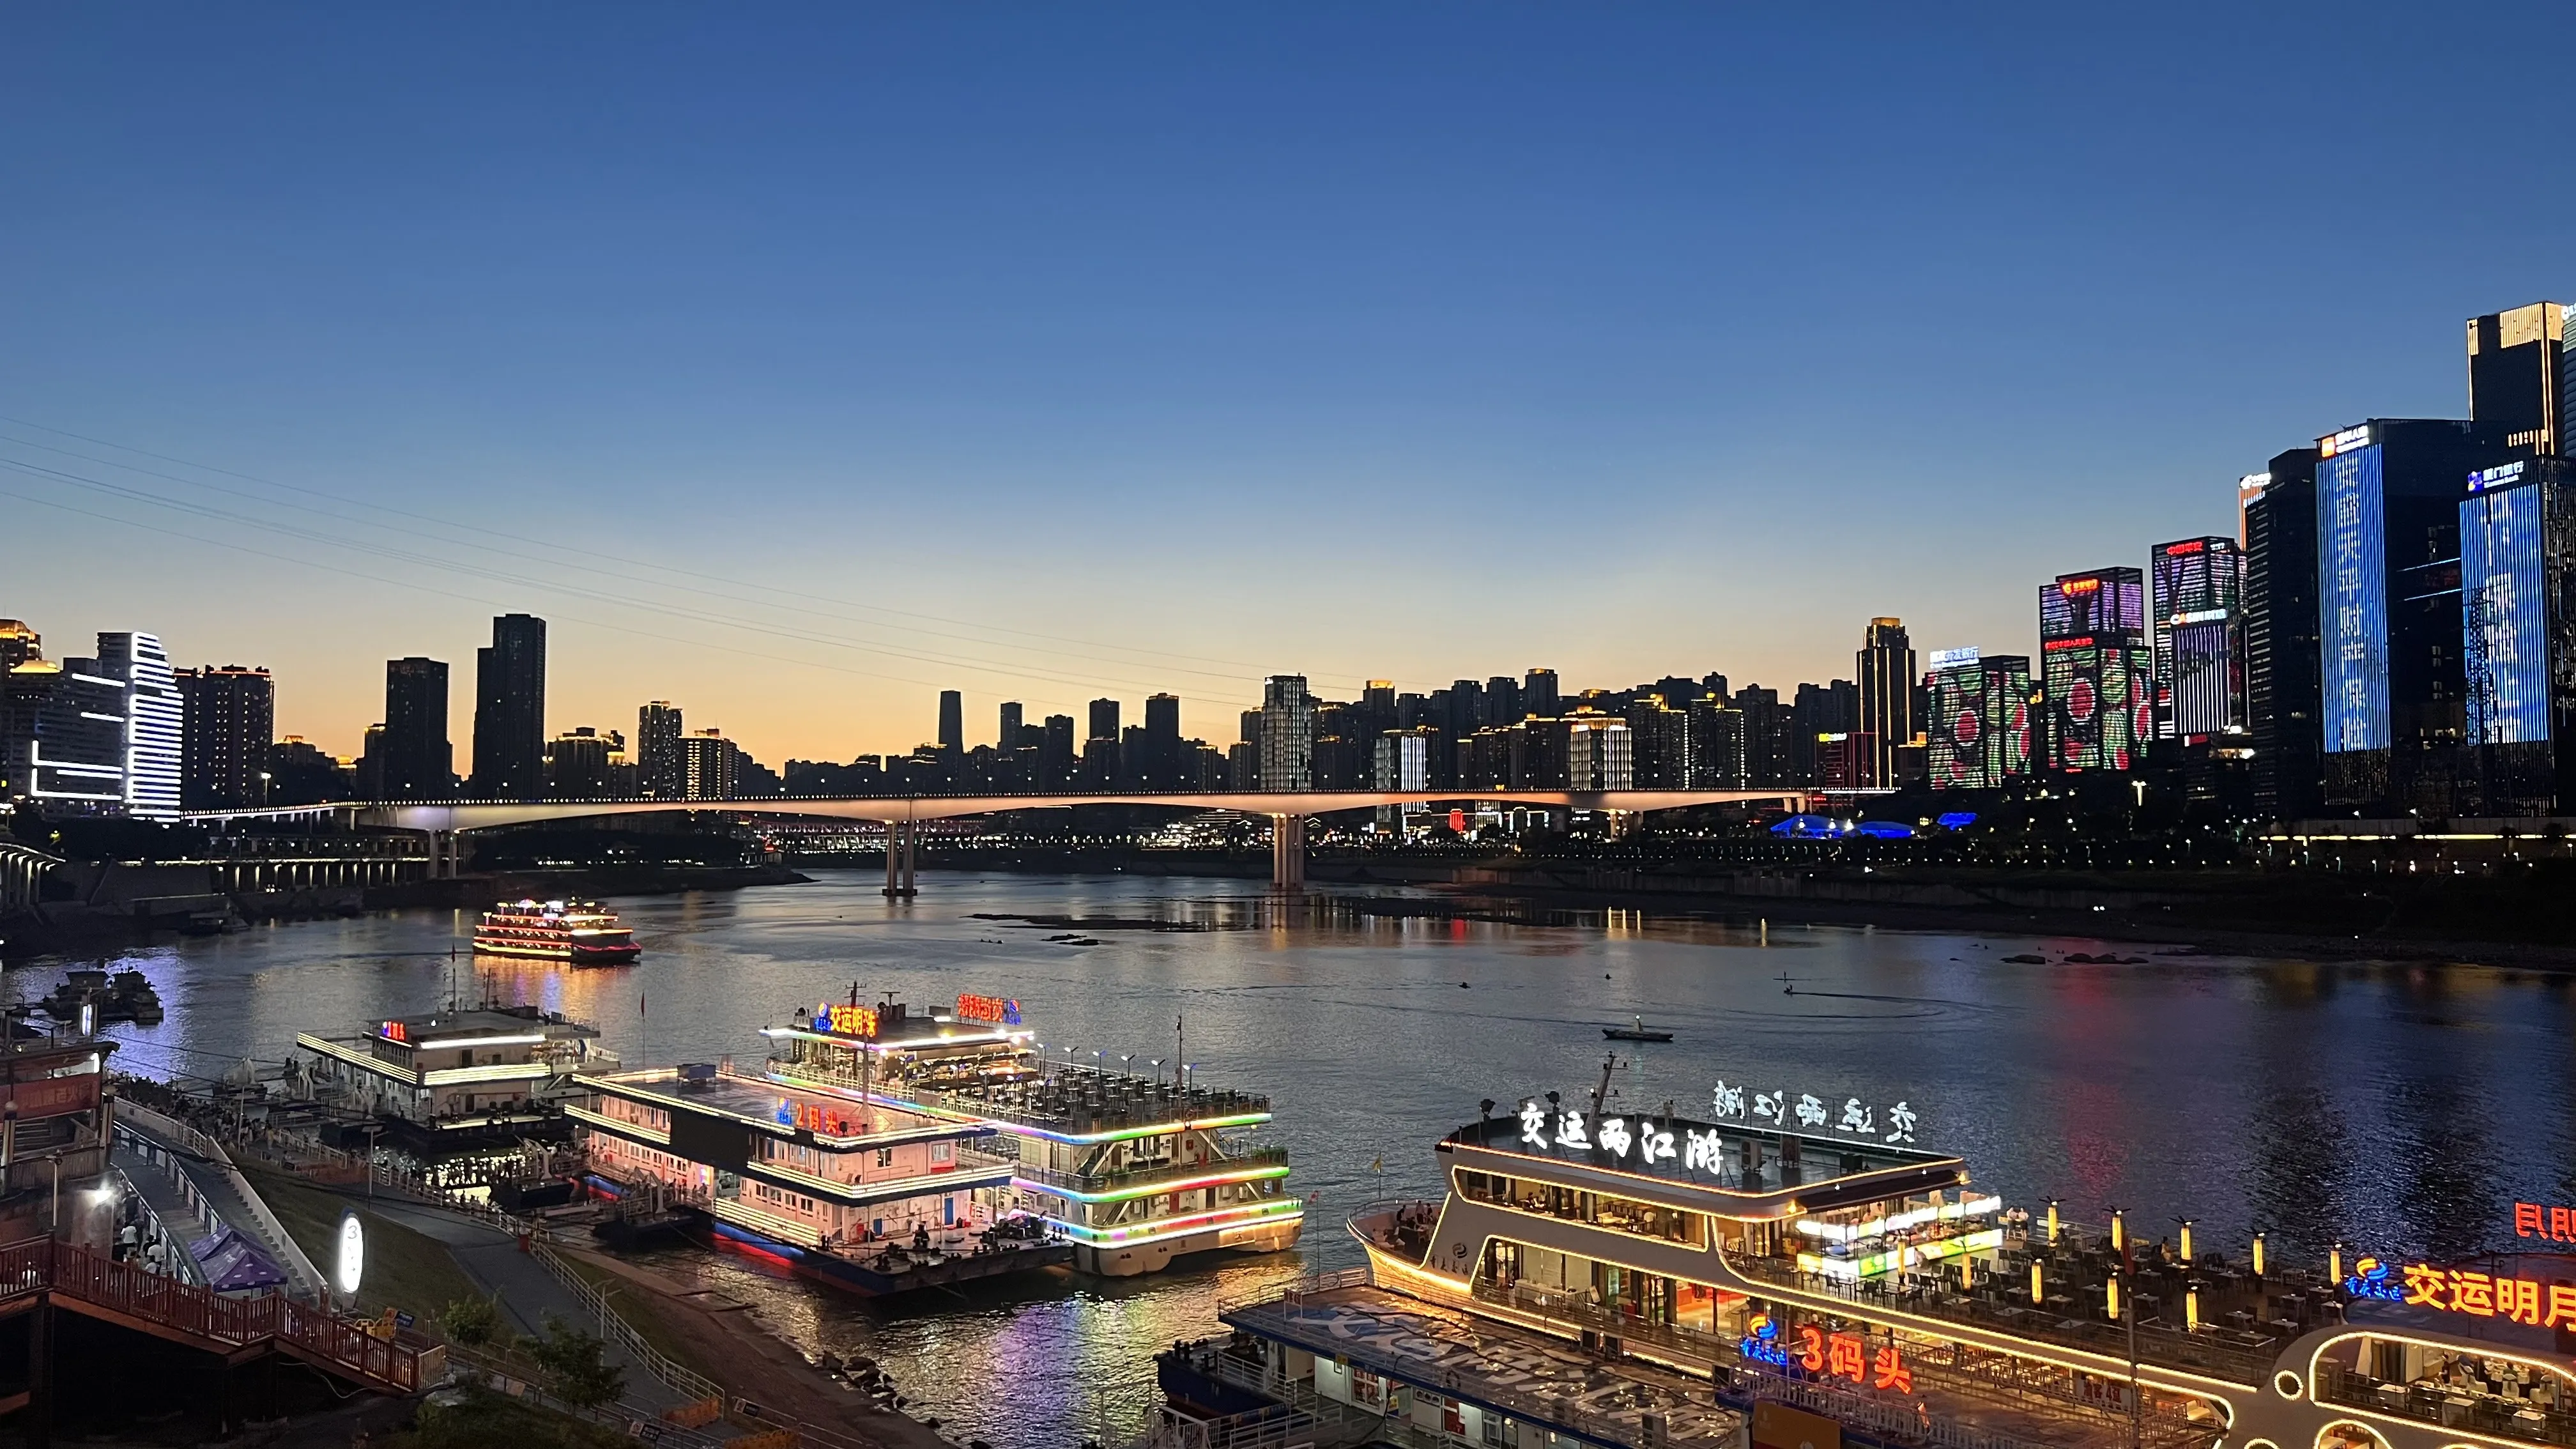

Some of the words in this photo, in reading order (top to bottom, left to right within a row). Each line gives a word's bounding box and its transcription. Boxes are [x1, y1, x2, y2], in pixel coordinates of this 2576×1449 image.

[2167, 542, 2202, 555] 中国平安
[1930, 647, 1979, 663] 开发银行
[830, 1005, 875, 1038] 交运明珠
[796, 1103, 837, 1134] 2码头
[1521, 1103, 1724, 1175] 交运两江游
[347, 1225, 358, 1239] 3
[2403, 1263, 2576, 1333] 交运明月
[1801, 1328, 1911, 1395] 3码头
